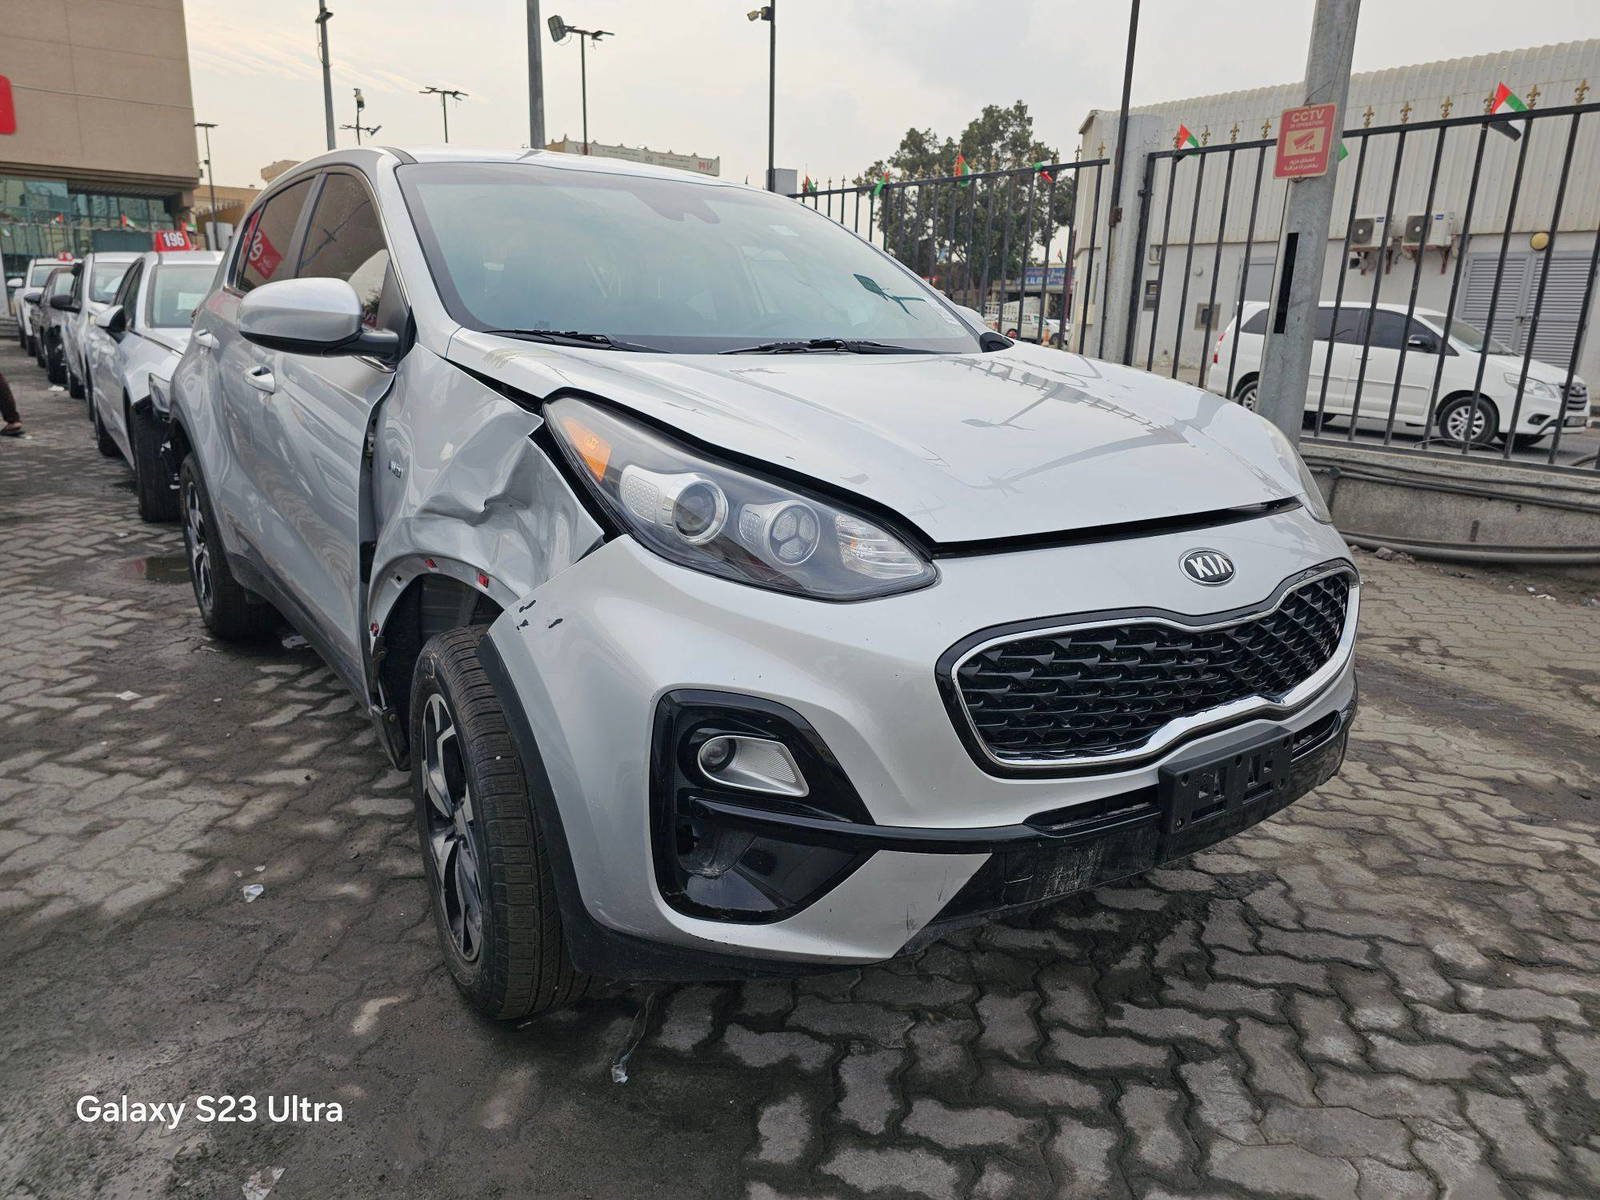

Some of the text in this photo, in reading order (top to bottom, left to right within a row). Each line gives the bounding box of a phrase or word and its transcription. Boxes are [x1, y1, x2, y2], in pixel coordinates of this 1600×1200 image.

[1291, 108, 1325, 122] CCTV
[163, 231, 185, 247] 196
[1187, 554, 1233, 578] KIA
